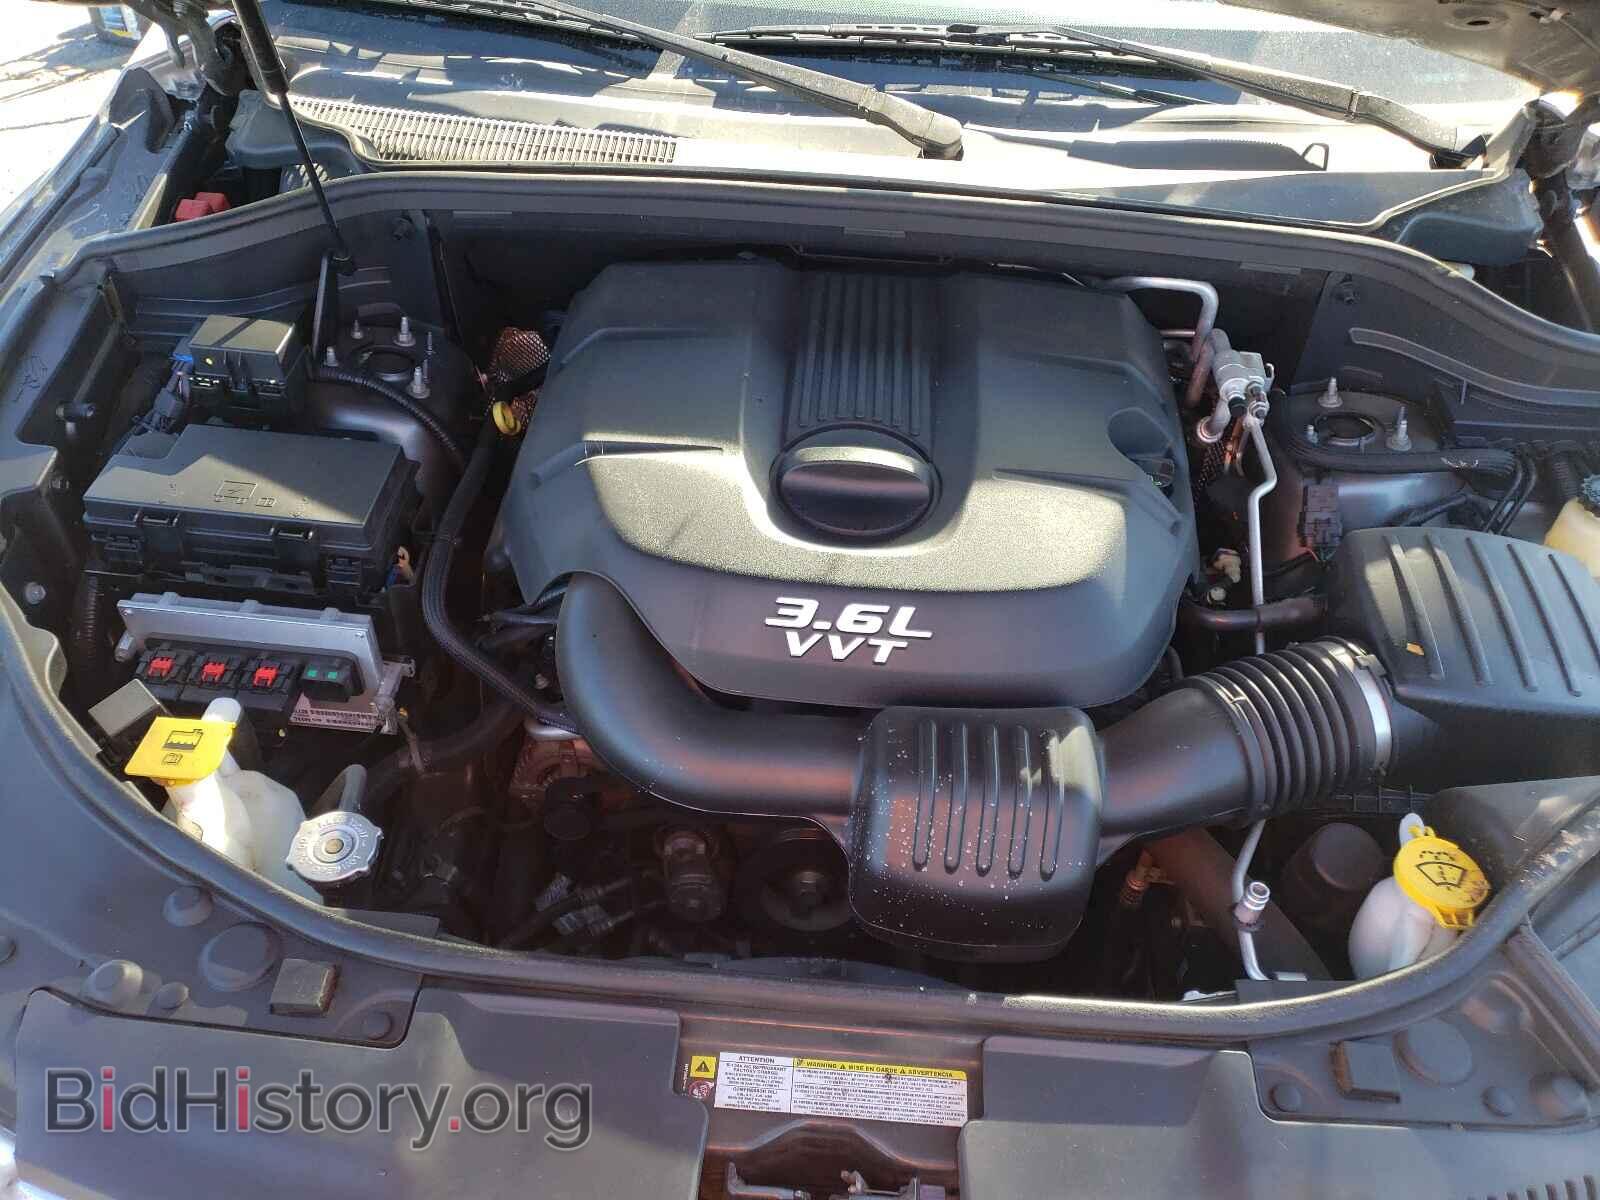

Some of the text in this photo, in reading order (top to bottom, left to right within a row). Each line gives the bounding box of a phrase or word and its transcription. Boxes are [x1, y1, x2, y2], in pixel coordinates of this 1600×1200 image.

[764, 596, 935, 640] 3.6L
[785, 631, 909, 666] VVT
[738, 1055, 775, 1064] ATTENTION
[806, 1061, 837, 1070] WARNING
[876, 1066, 898, 1074] GARDE
[908, 1069, 953, 1078] ADVERTENCIA
